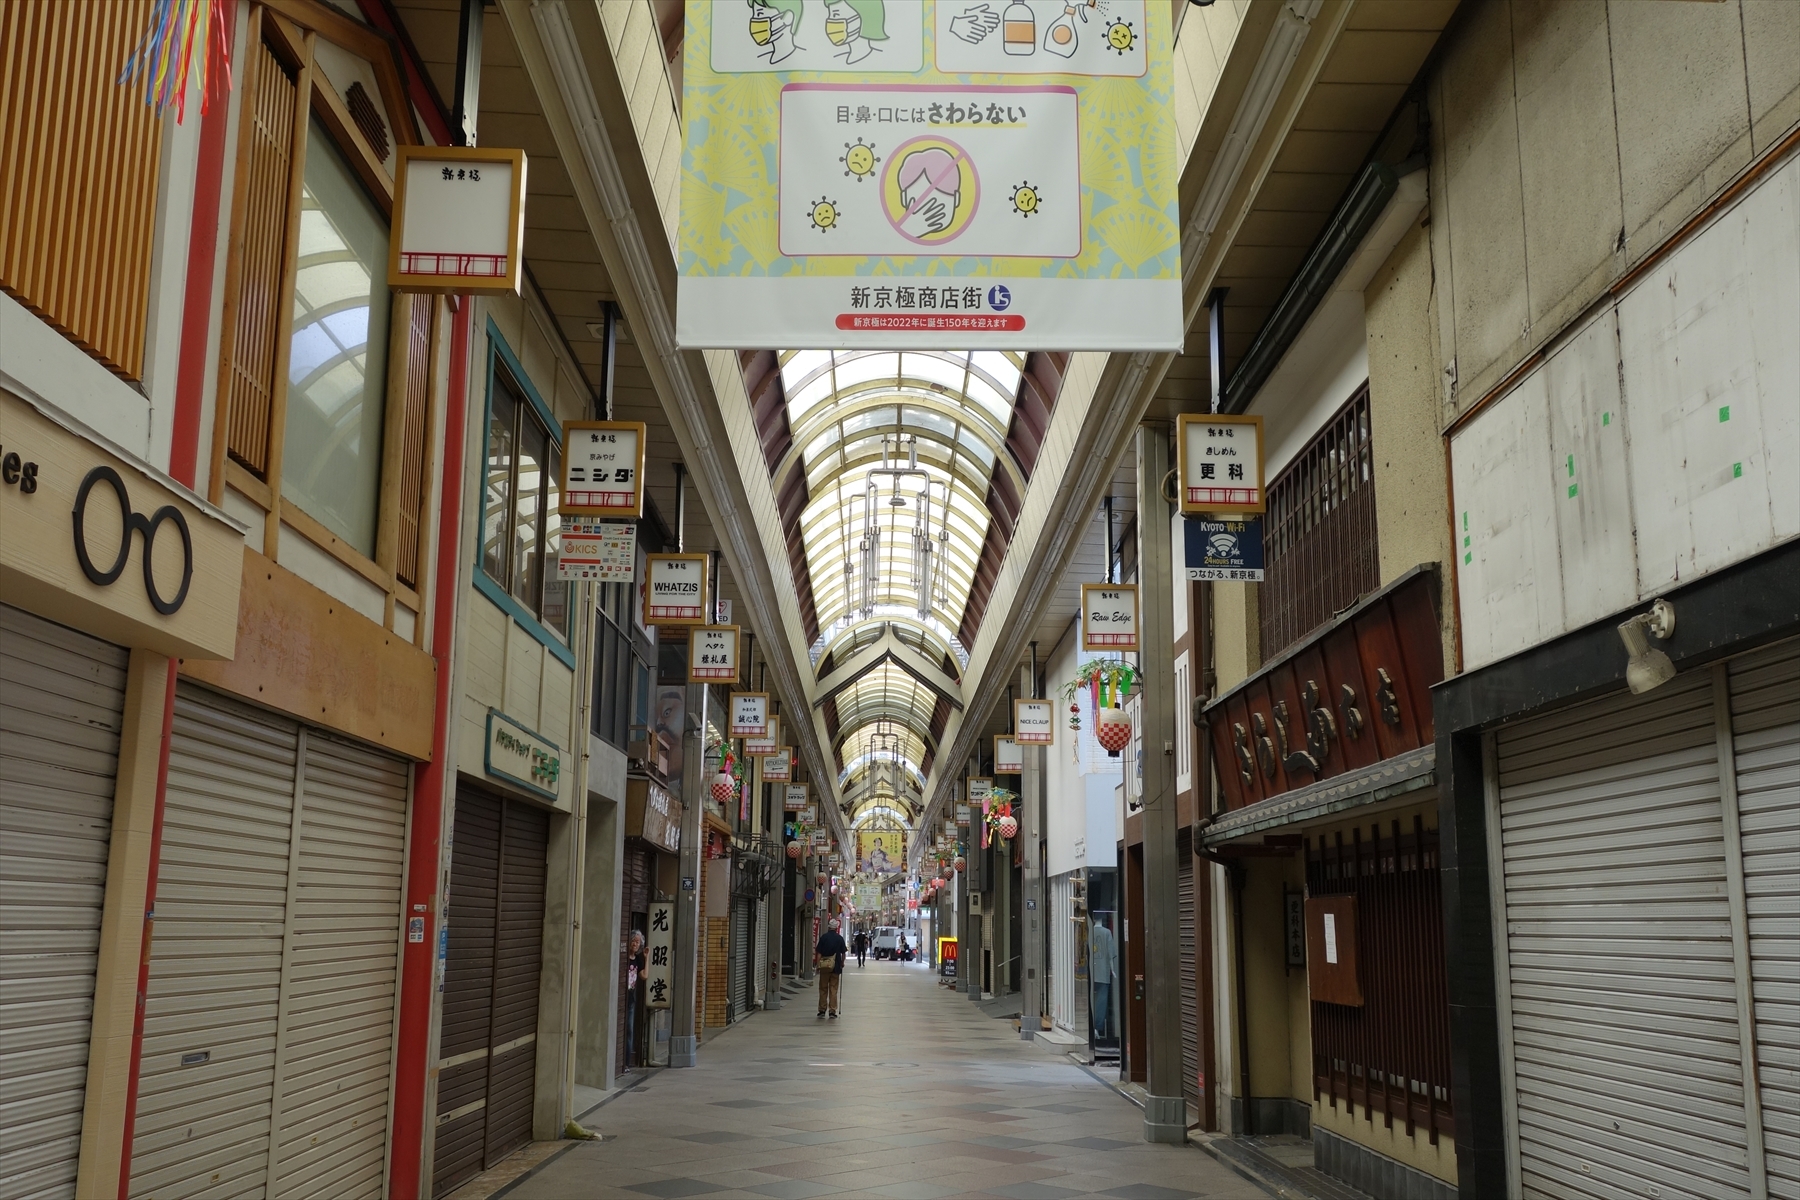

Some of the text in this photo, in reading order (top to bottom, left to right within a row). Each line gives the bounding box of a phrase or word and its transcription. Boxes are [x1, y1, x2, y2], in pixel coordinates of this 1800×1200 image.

[850, 285, 983, 309] 新京極商店街
[853, 317, 1008, 328] 新京極は2022年に誕生150年を迎えます
[589, 453, 616, 461] 京みやげ
[1205, 446, 1237, 457] きしめん
[569, 467, 634, 483] ニシダ
[1200, 463, 1244, 481] 更科
[1200, 521, 1245, 532] KYOTO Wi-Fi
[575, 545, 598, 554] KICS
[1190, 569, 1261, 580] つながる、新京極。
[654, 582, 698, 592] WHATZIS
[1091, 611, 1132, 624] Raw Edge
[738, 715, 760, 724] 誠心院
[650, 908, 669, 1003] 光昭堂
